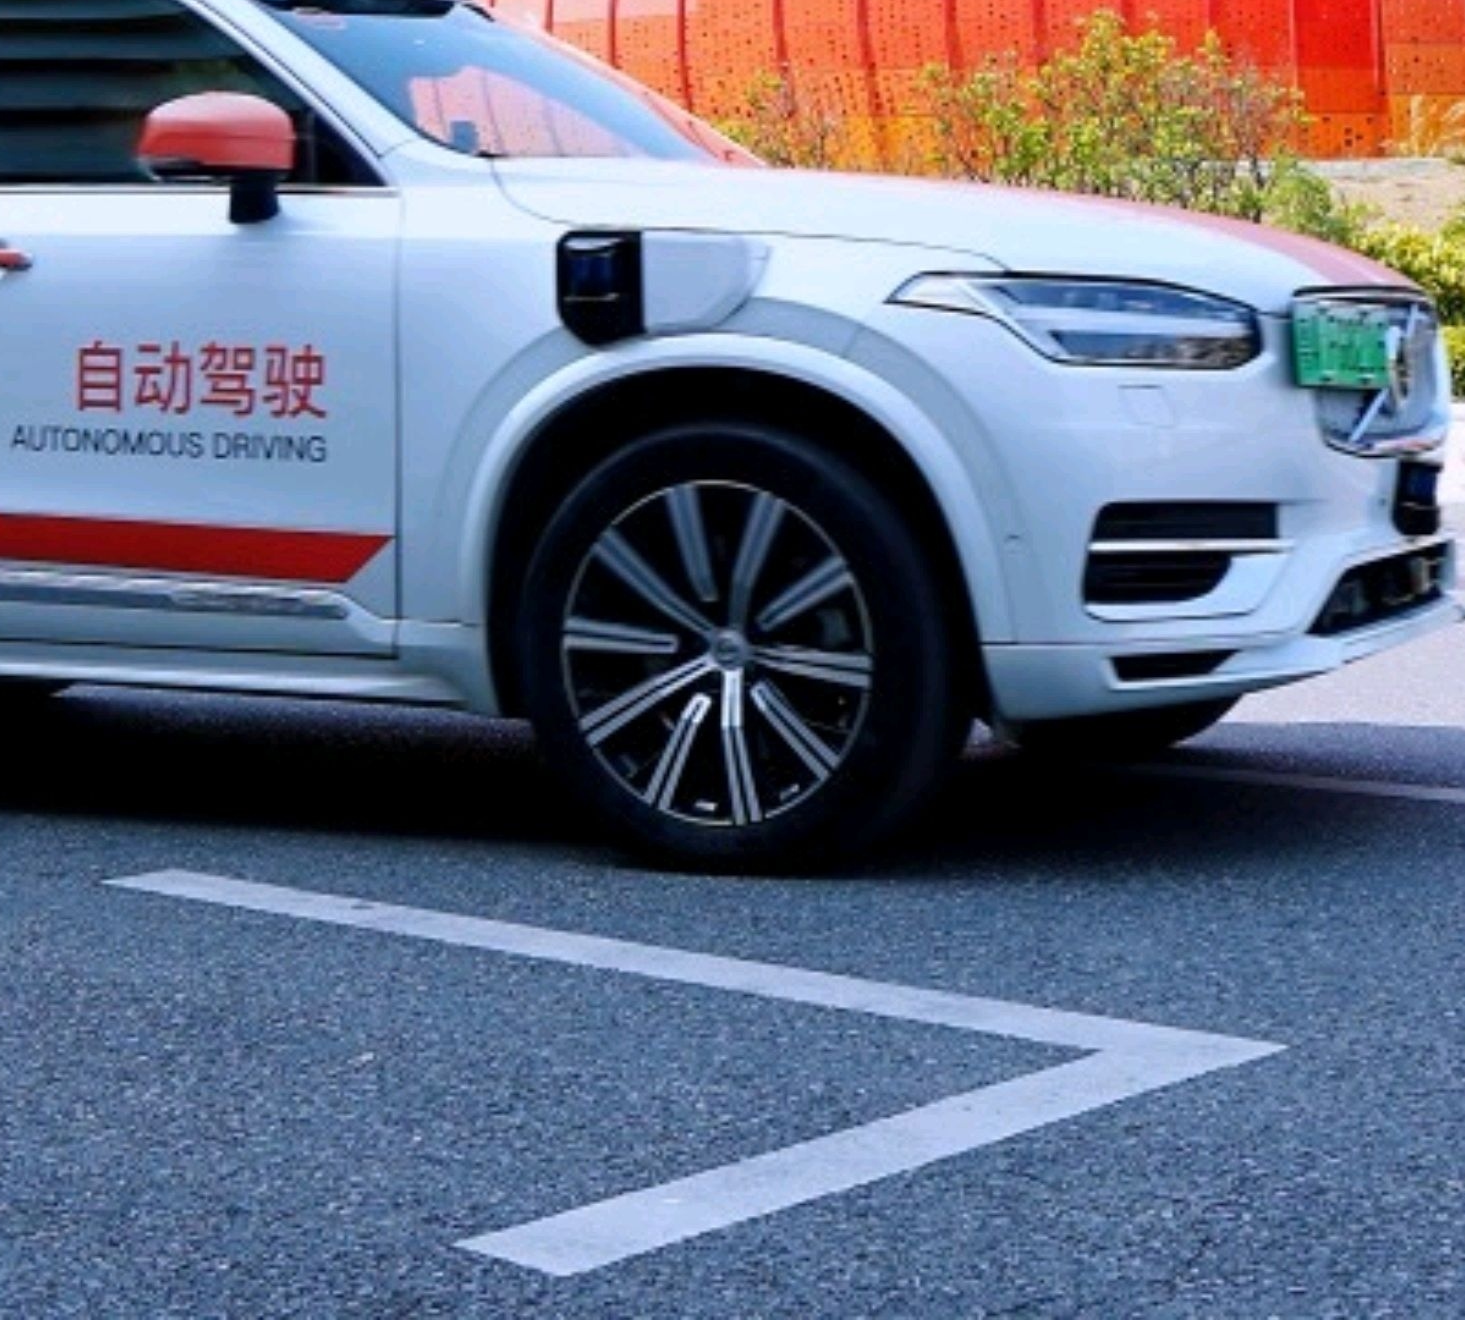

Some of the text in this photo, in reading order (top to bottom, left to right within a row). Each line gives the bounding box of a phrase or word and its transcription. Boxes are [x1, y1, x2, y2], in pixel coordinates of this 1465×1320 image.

[76, 340, 327, 419] 自动驾驶
[10, 424, 327, 463] AUTONOMOUS DRIVING
